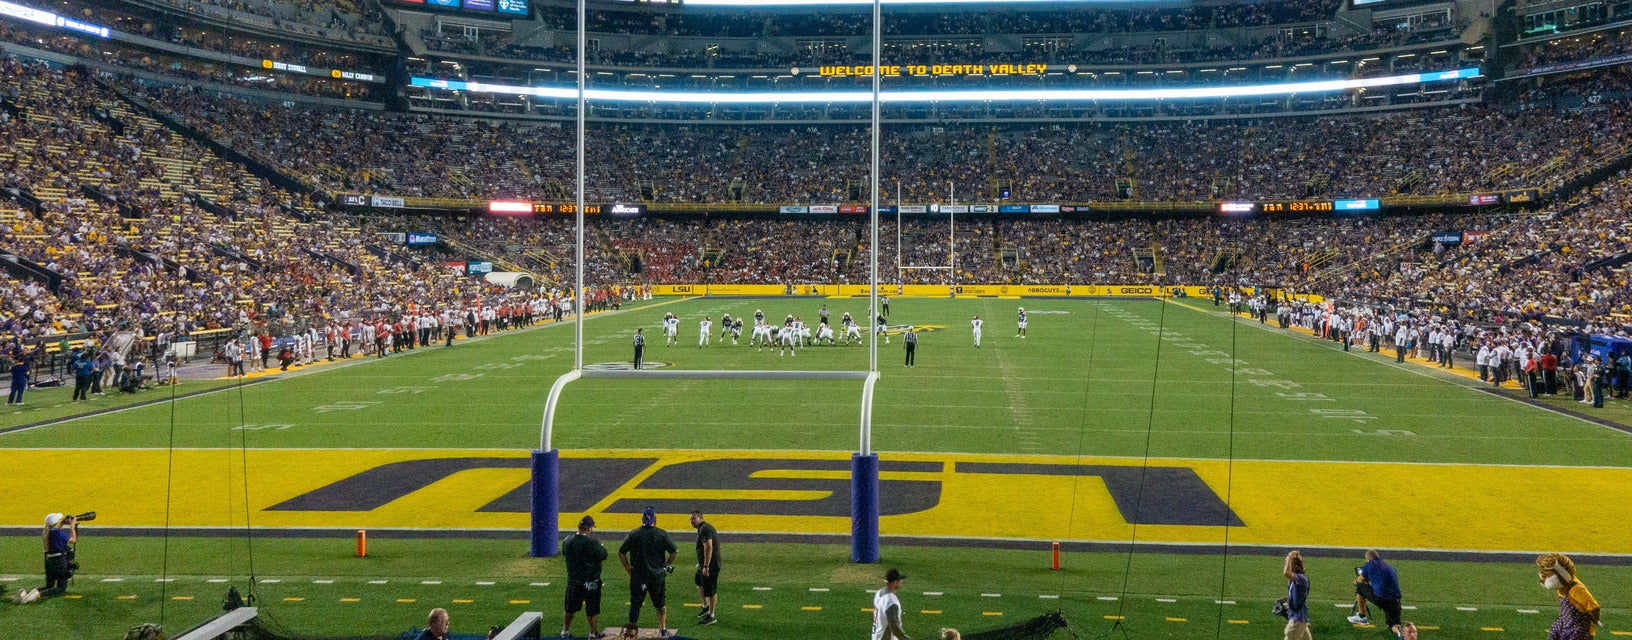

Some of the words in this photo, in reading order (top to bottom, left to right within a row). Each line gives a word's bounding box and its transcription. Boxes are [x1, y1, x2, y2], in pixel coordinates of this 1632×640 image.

[820, 65, 900, 76] WELCOME
[906, 65, 927, 75] TO
[932, 64, 983, 75] DEATH
[989, 63, 1047, 74] VALLEY
[415, 234, 437, 243] Marathon
